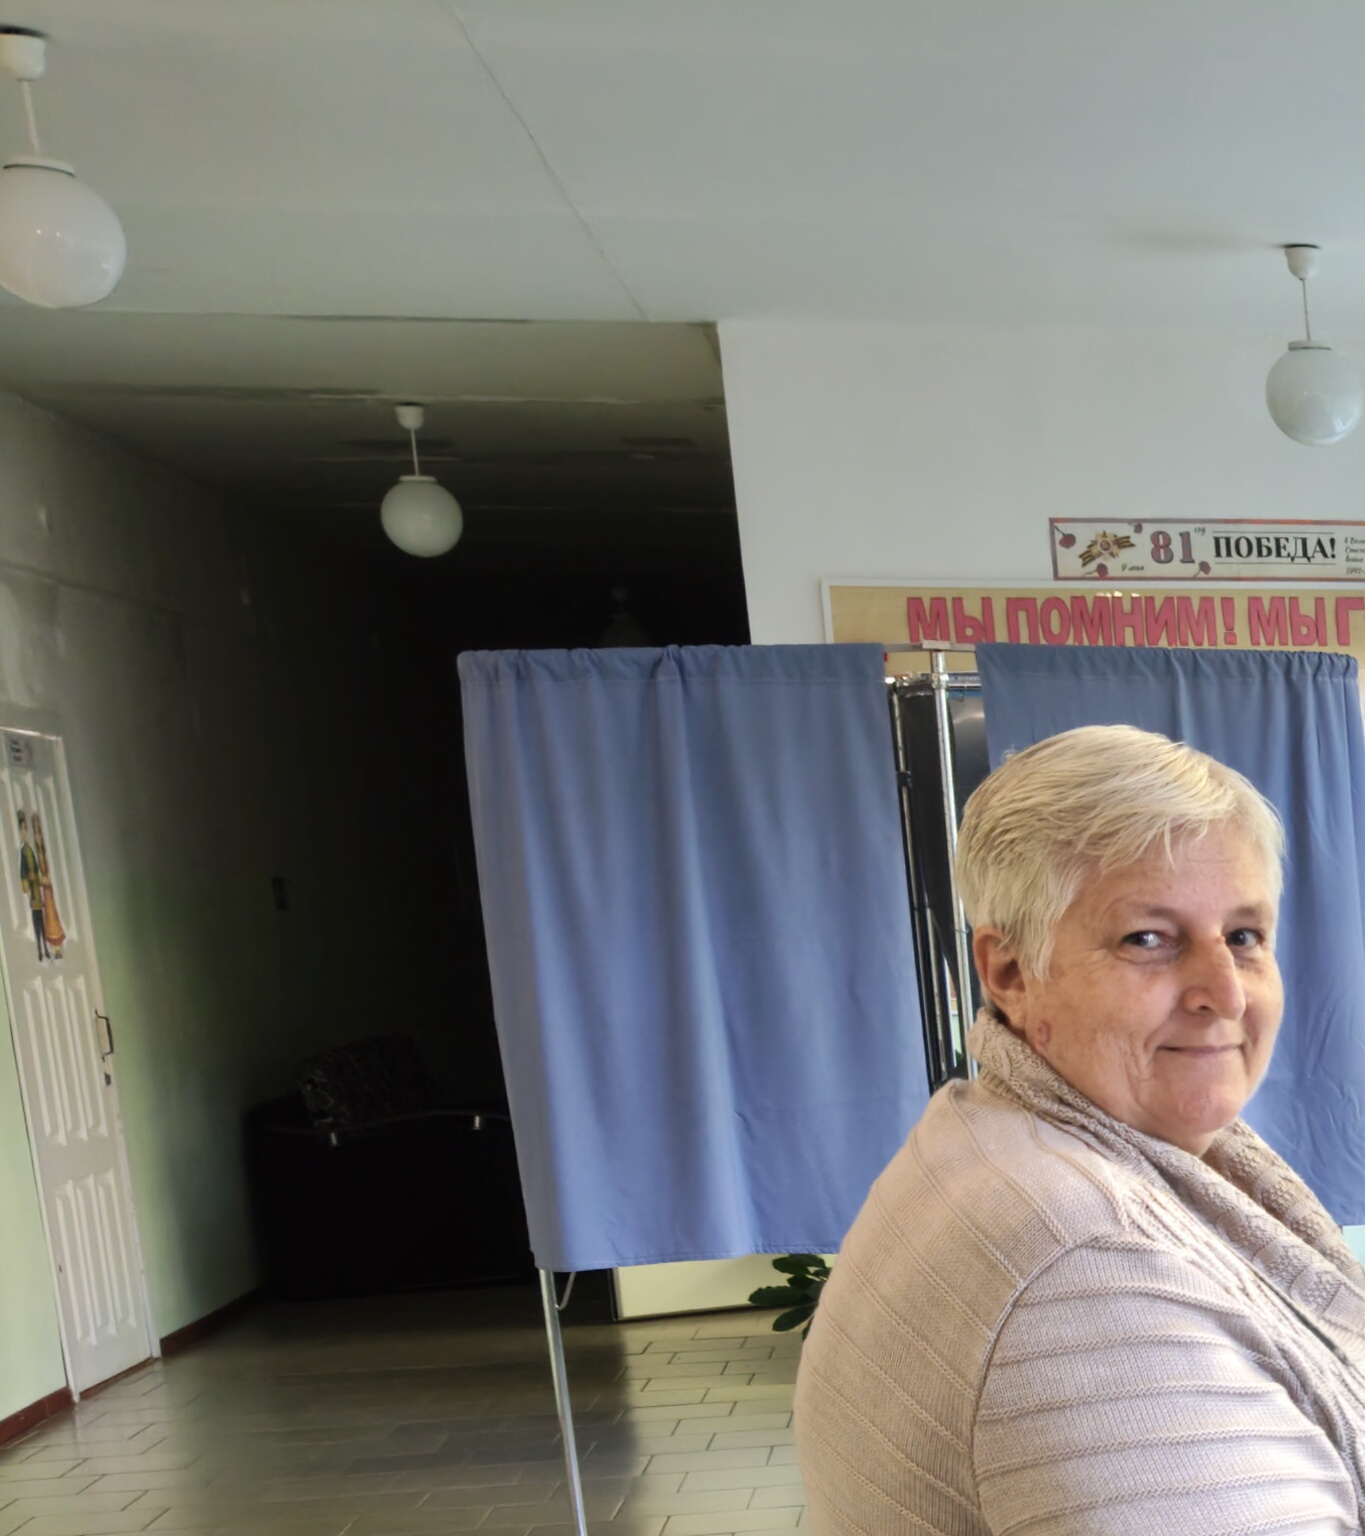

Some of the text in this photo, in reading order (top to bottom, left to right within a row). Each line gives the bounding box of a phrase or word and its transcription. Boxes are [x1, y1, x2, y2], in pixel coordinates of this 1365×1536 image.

[1150, 530, 1196, 564] 81
[1213, 535, 1337, 564] ПОБЕДА!
[906, 596, 996, 645] МЫ
[1005, 595, 1238, 647] ПОМНИМ!
[1247, 596, 1330, 648] МЫ
